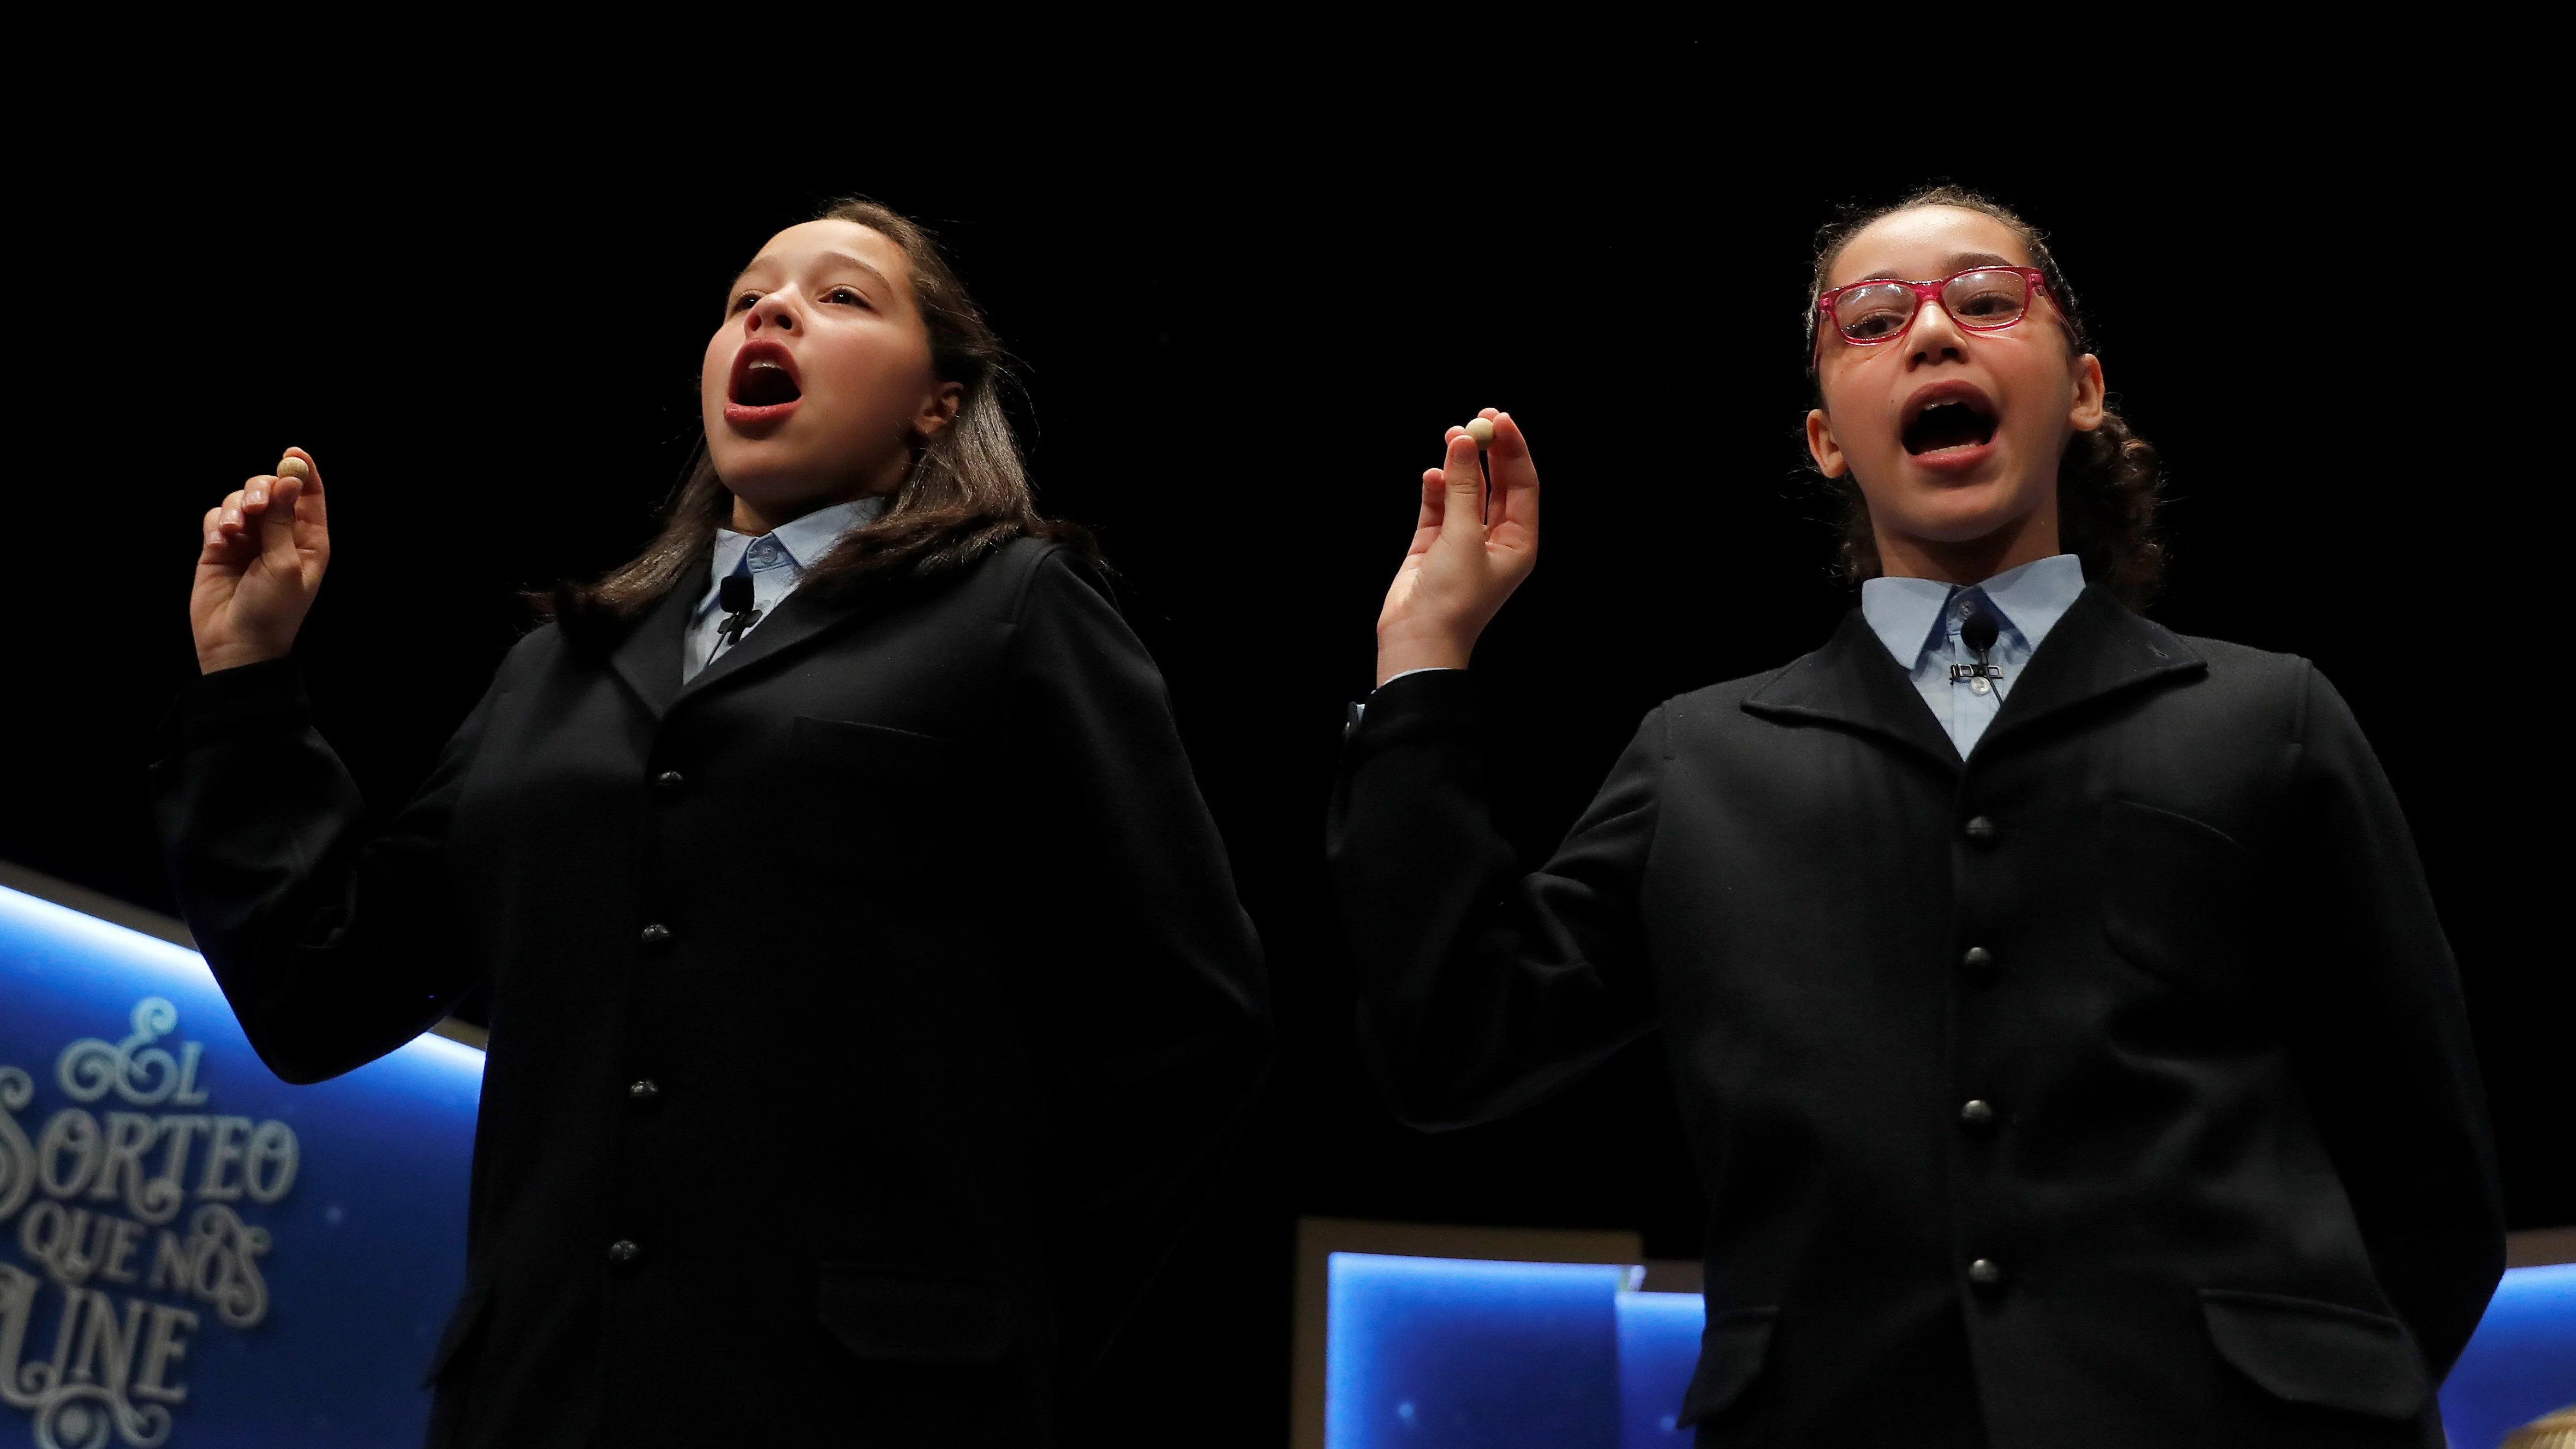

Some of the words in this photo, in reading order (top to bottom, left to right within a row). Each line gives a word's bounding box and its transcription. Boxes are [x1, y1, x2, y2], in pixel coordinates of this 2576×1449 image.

[57, 997, 210, 1106] EL
[20, 1202, 146, 1283] QUE
[150, 1203, 271, 1328] NOS
